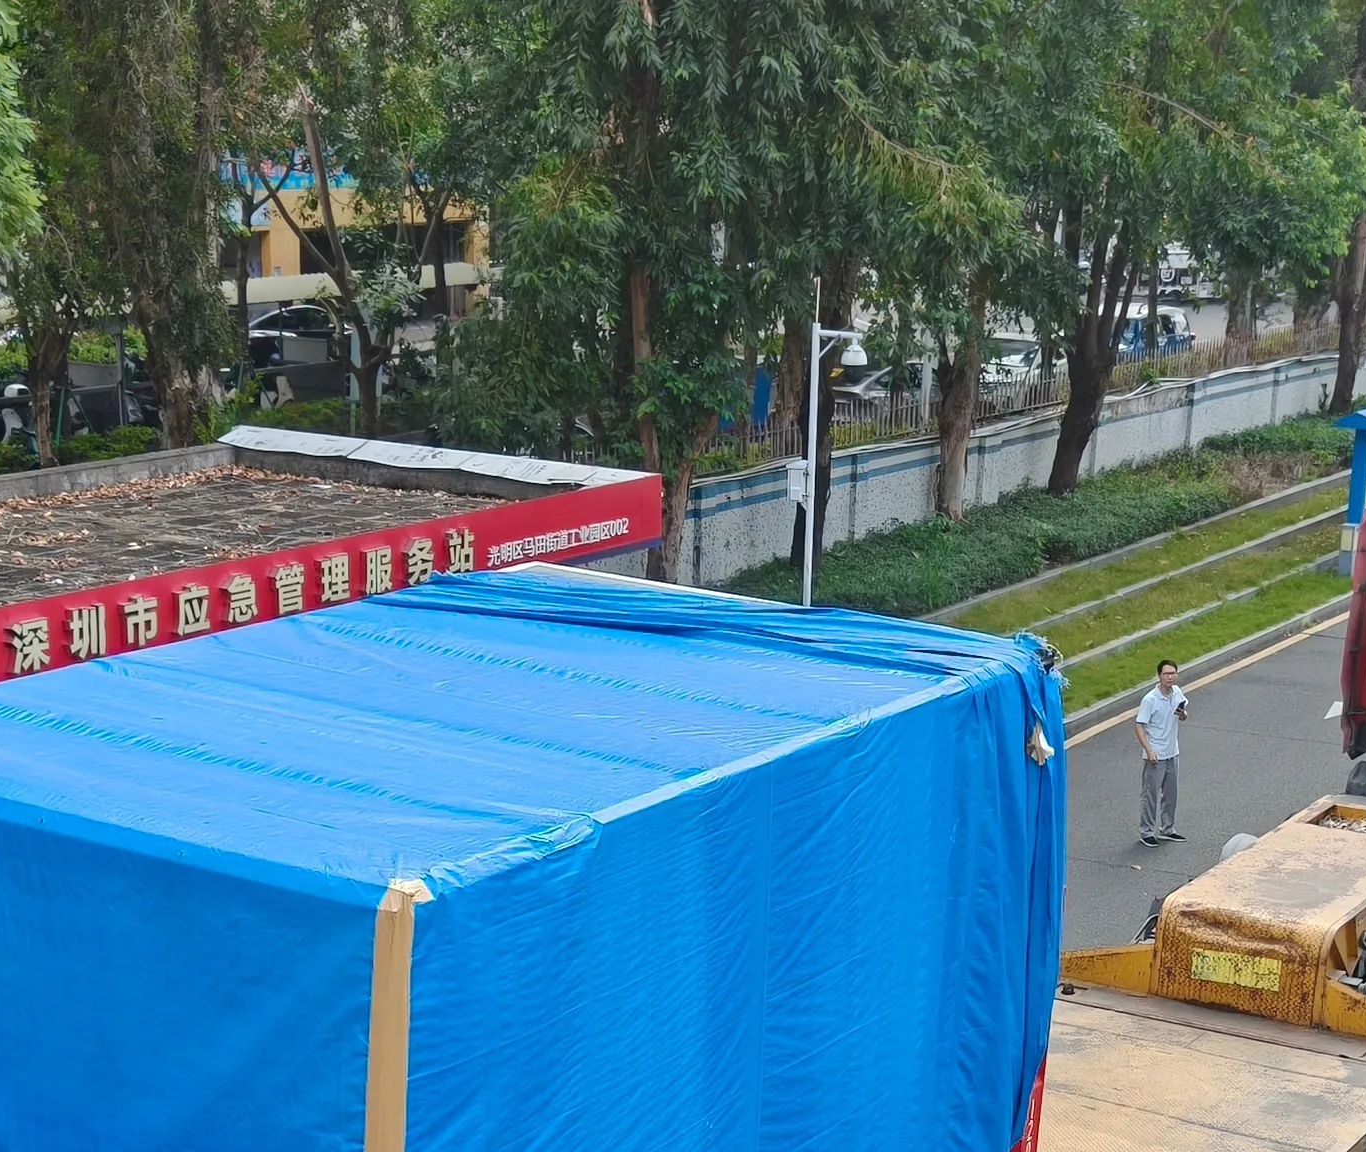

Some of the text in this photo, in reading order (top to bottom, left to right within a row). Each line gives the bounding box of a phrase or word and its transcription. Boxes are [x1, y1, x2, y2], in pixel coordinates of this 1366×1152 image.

[9, 528, 475, 674] 深圳市应急管理服务站
